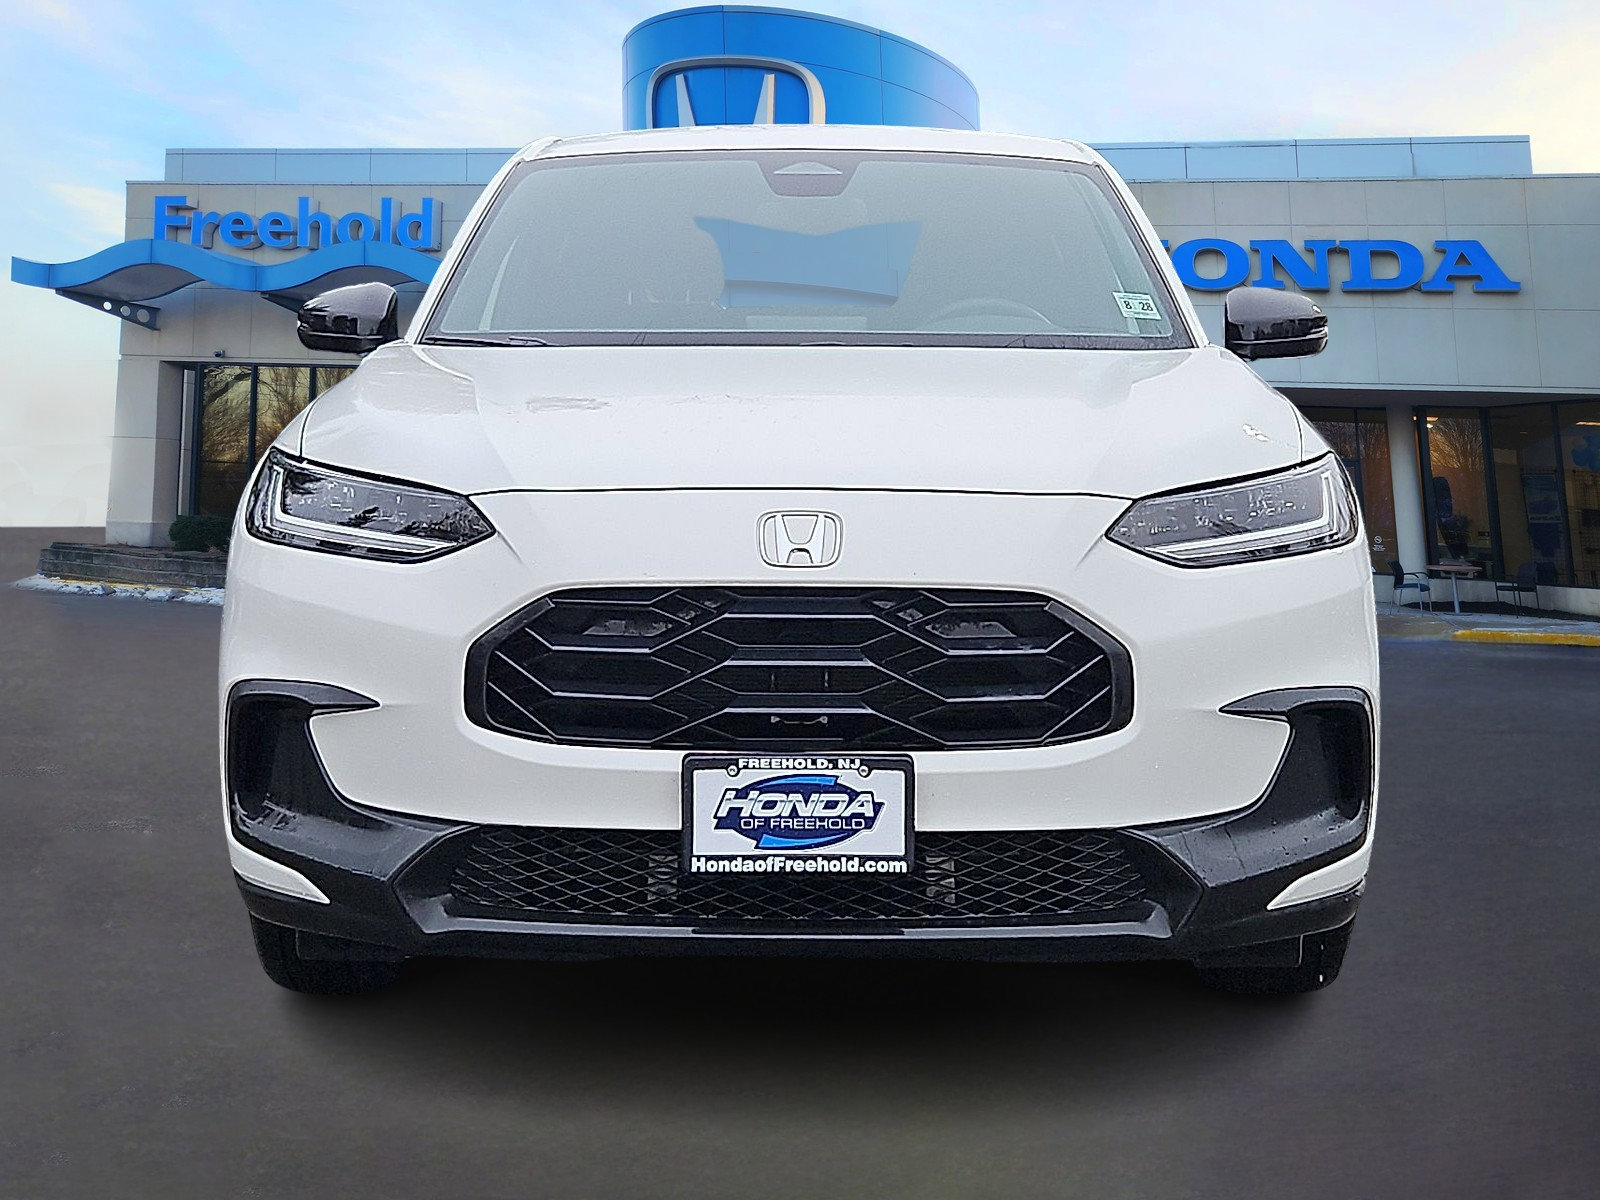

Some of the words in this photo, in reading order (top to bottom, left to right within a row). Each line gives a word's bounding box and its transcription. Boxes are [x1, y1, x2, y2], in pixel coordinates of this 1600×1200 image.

[153, 195, 442, 252] Freehold
[1162, 238, 1521, 293] ONDA
[1123, 300, 1133, 310] 8
[1138, 301, 1154, 312] 28
[738, 758, 834, 770] FREEHOLD,
[837, 758, 861, 770] NJ
[716, 790, 875, 818] HONDA
[740, 818, 765, 830] OF
[770, 818, 866, 830] FREEHOLD
[691, 856, 908, 873] HondaofFreehold.com
